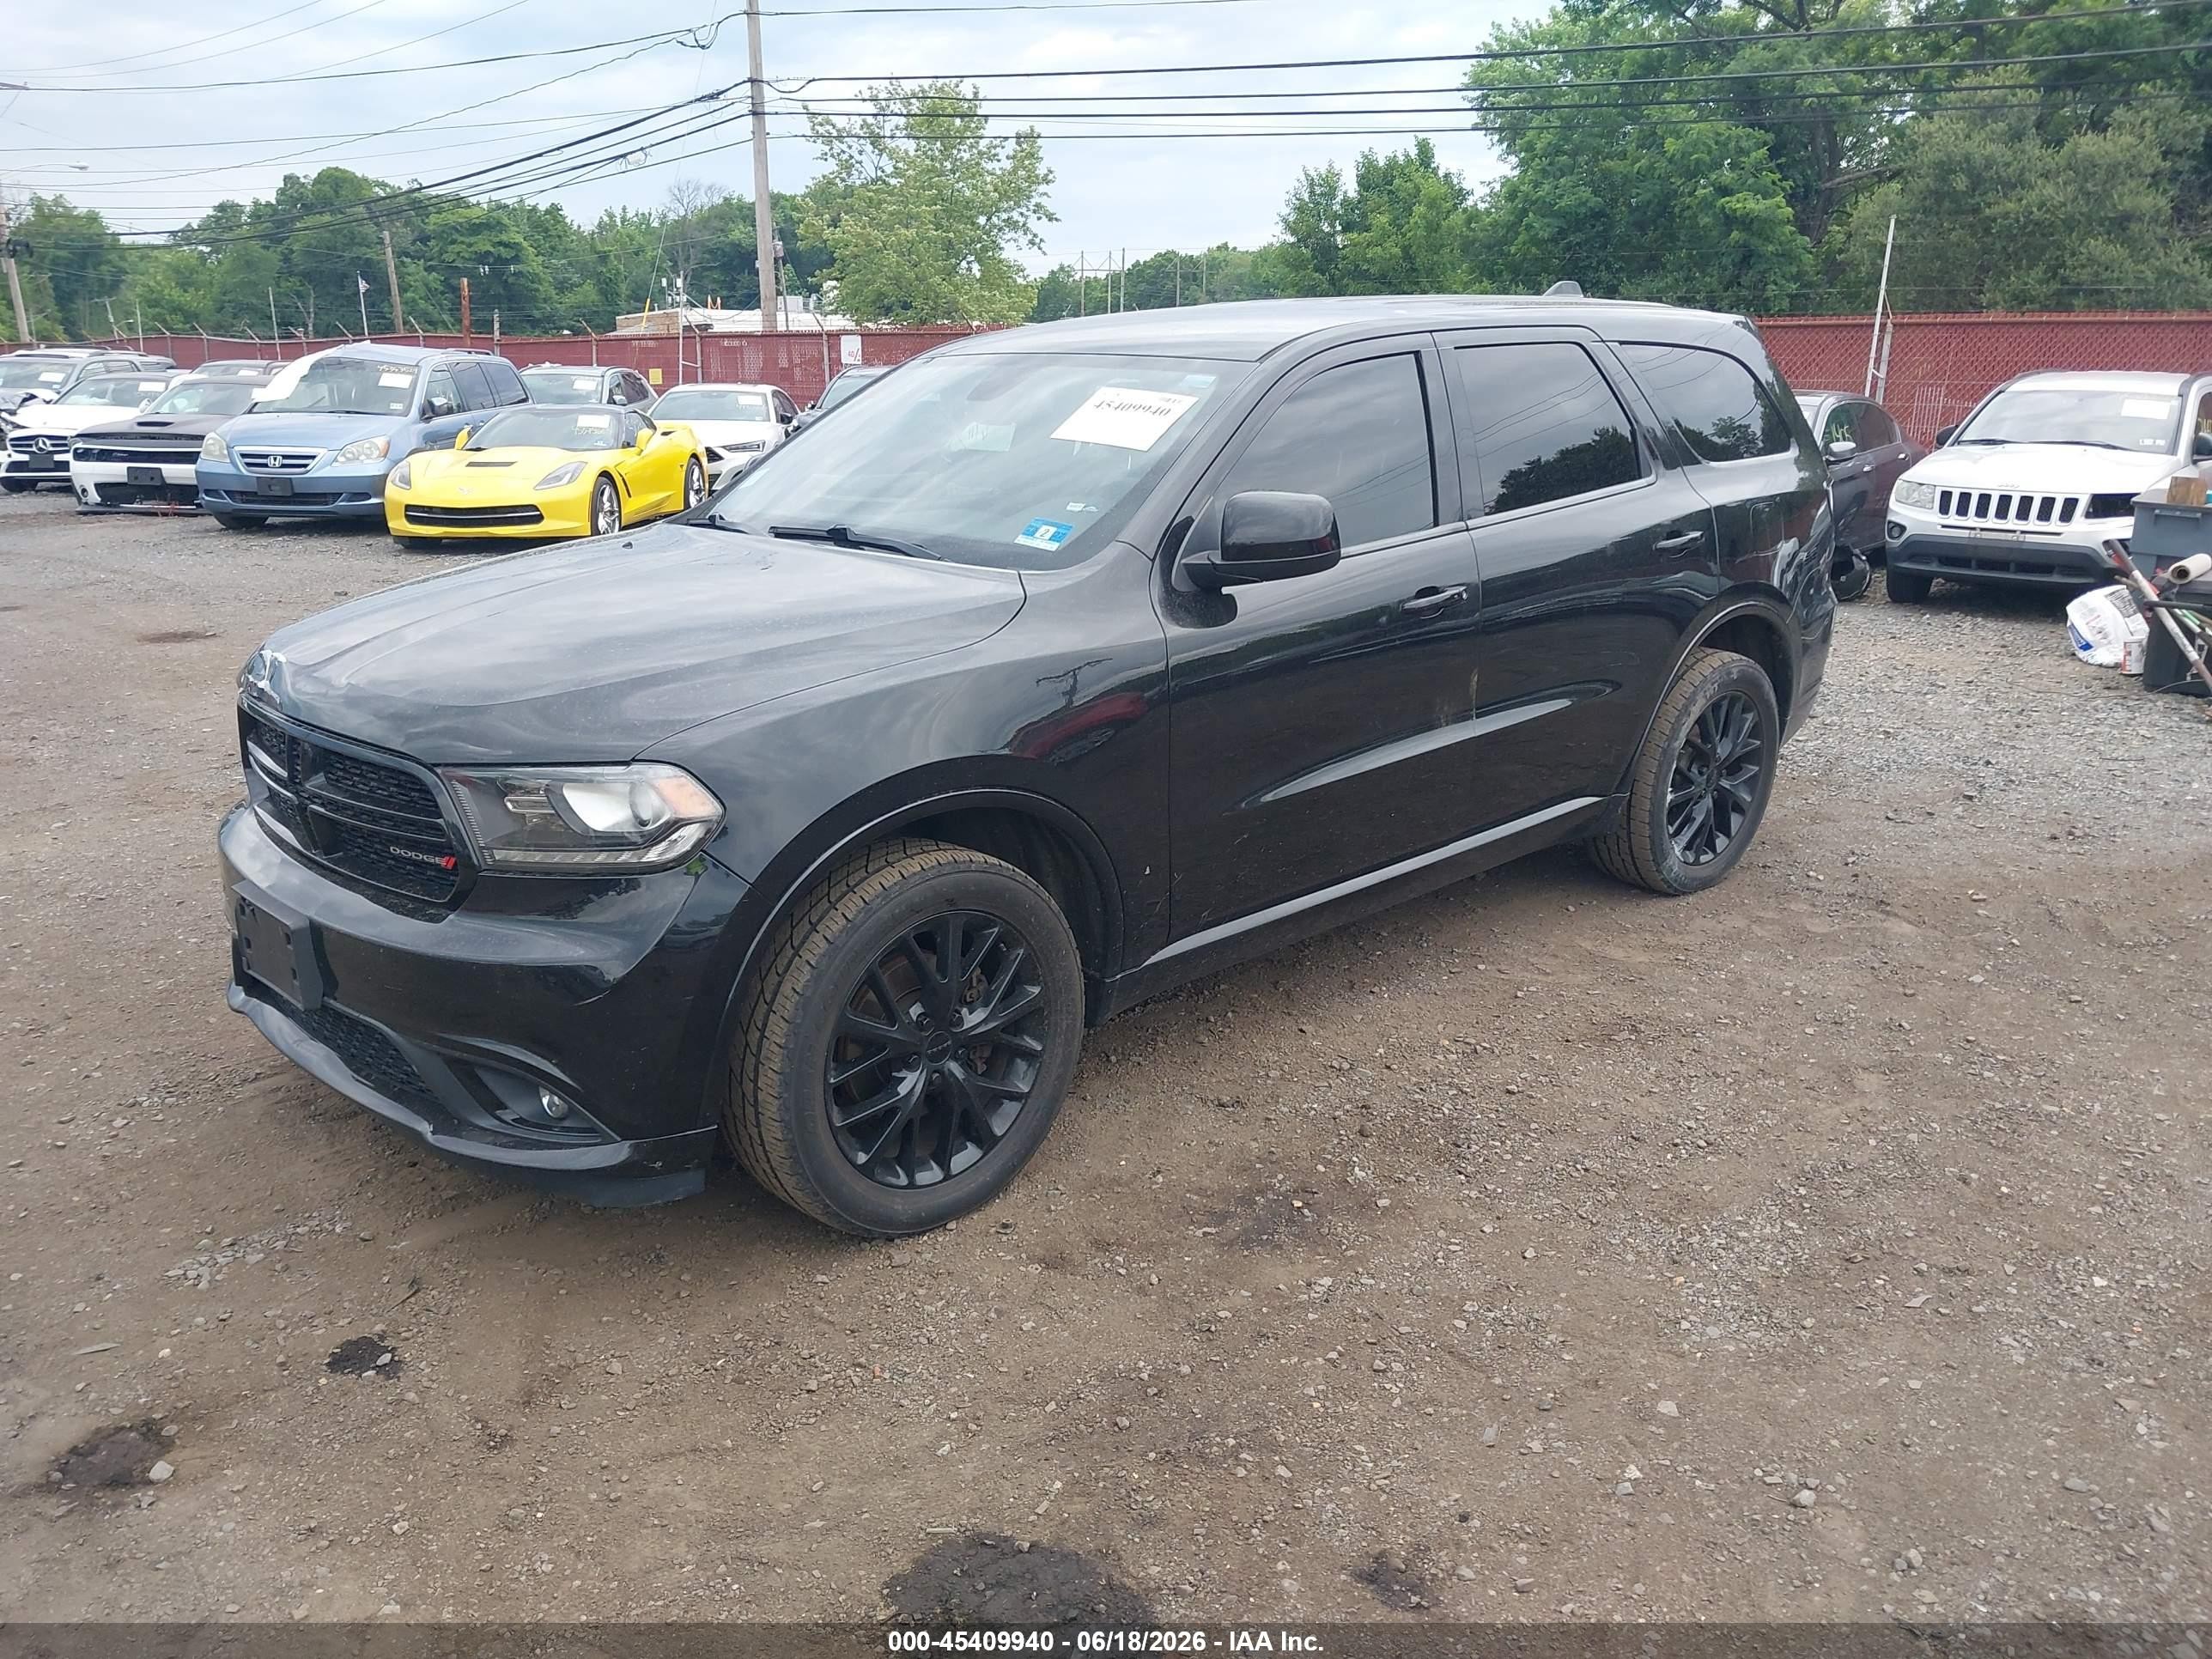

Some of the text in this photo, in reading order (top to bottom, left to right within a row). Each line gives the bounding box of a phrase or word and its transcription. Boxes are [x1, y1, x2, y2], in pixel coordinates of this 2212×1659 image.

[1093, 399, 1172, 416] 45409940
[1039, 528, 1050, 538] 2
[389, 846, 447, 866] DODGE
